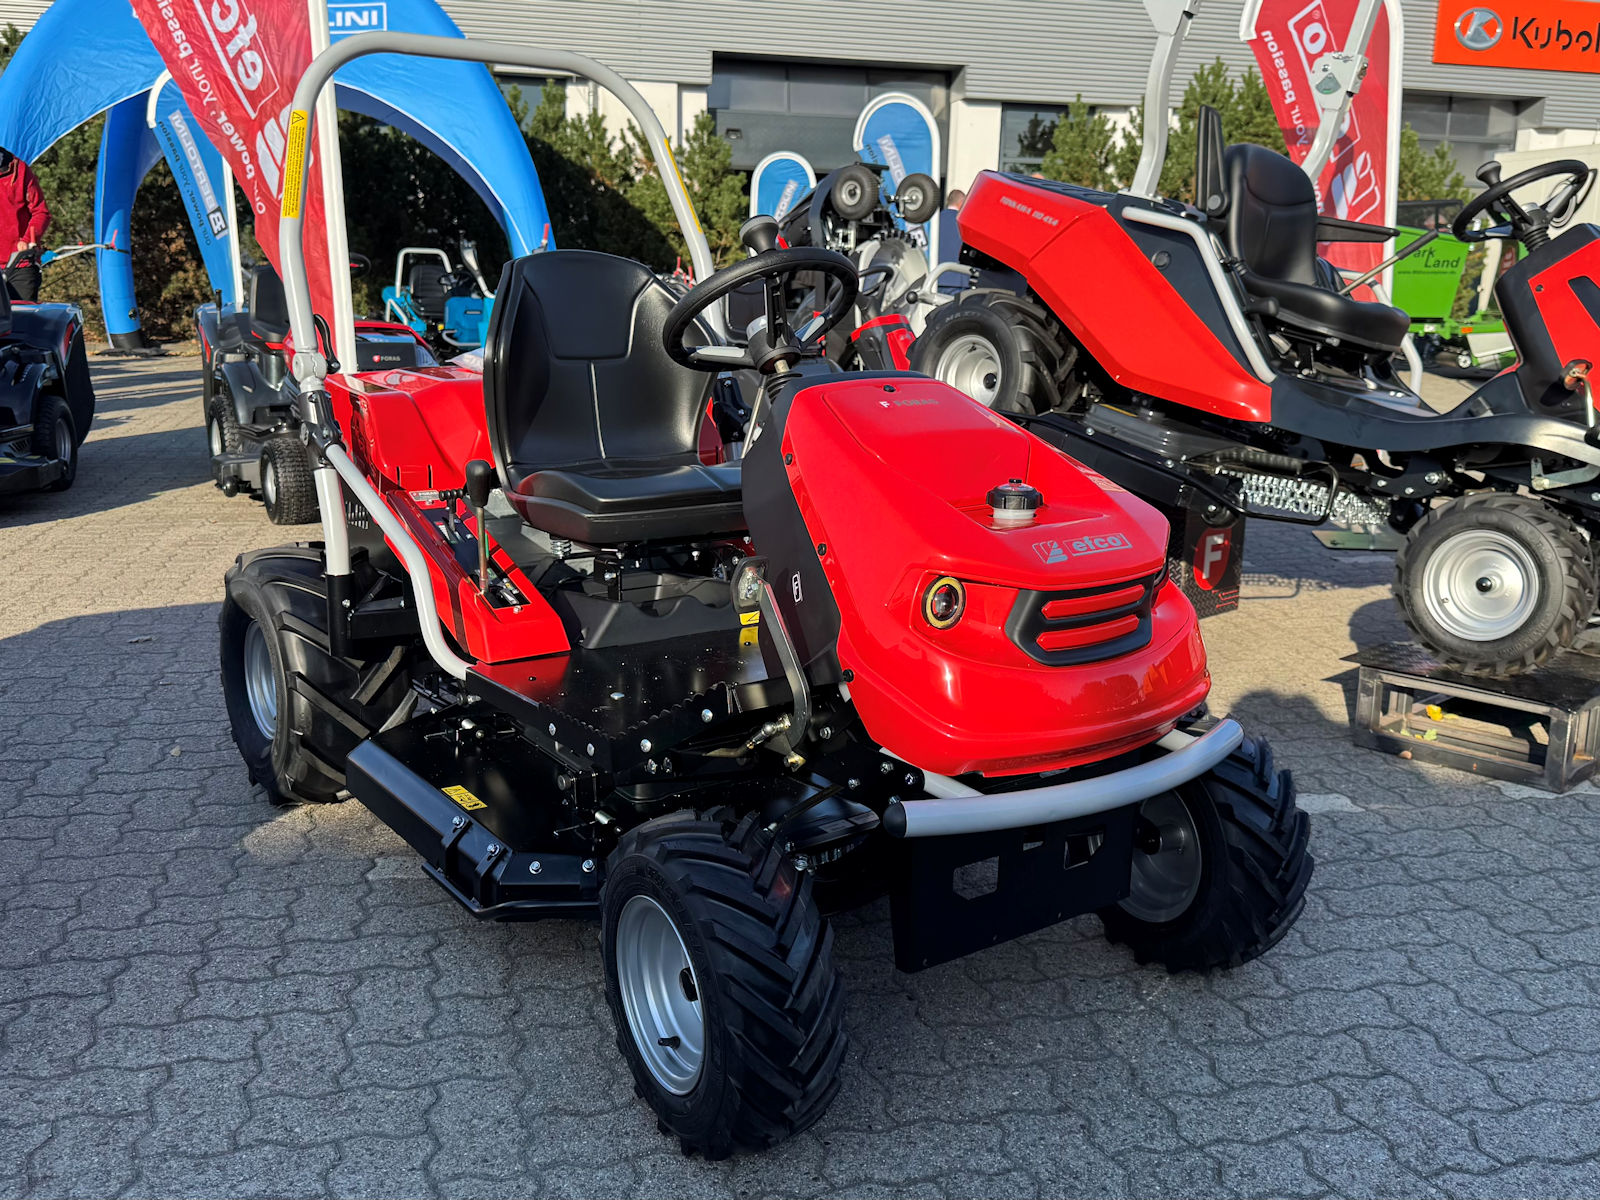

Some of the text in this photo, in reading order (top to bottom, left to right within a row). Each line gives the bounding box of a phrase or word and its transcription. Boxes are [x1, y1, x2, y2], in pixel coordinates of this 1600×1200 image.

[1411, 246, 1436, 259] ark
[1424, 253, 1460, 269] Land
[1072, 536, 1122, 552] efco
[1202, 533, 1225, 580] F
